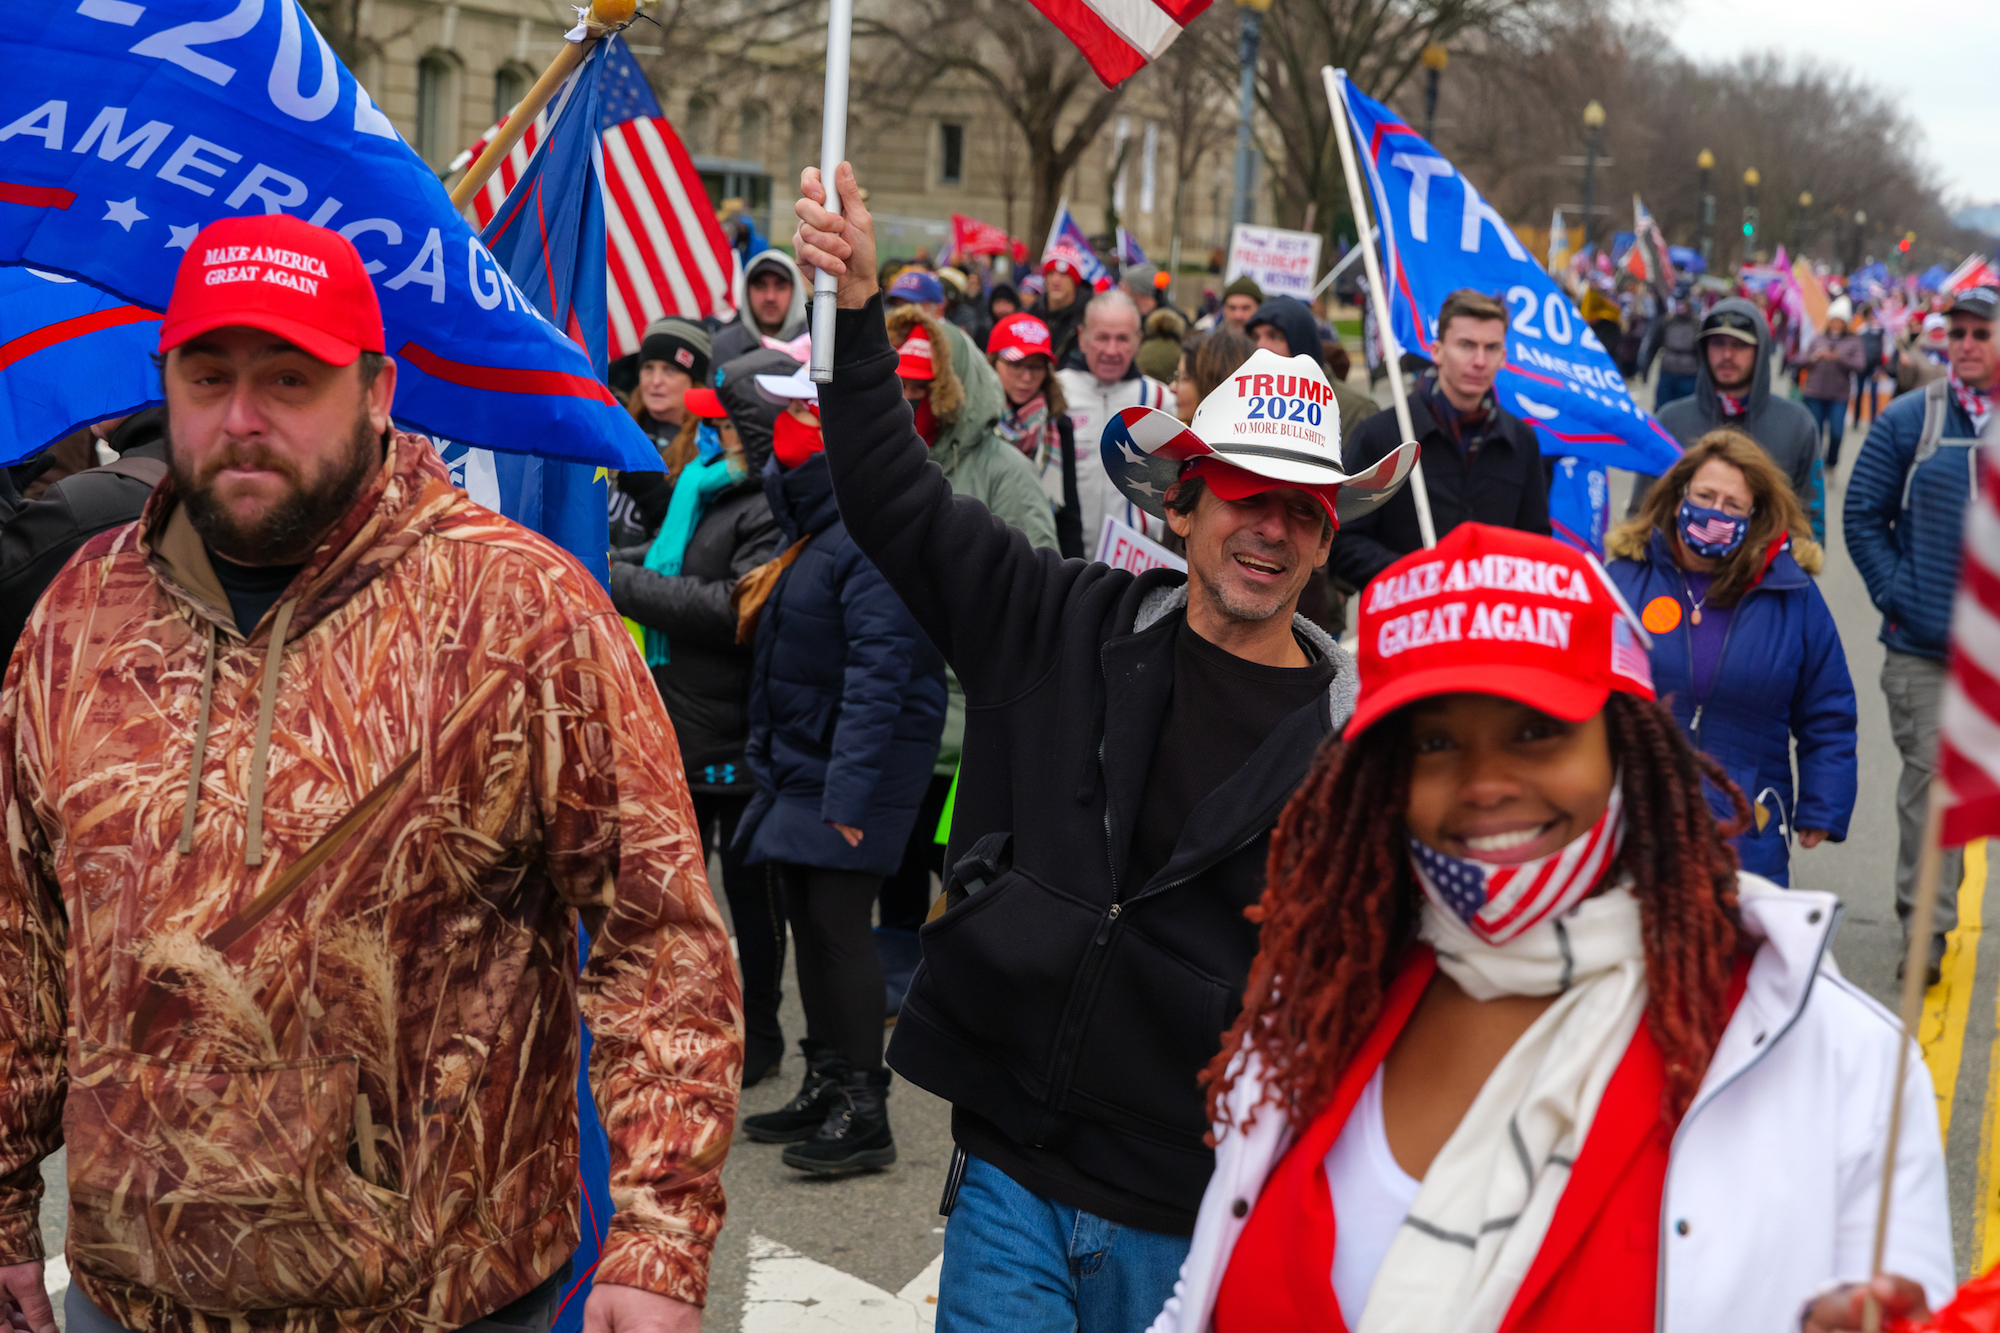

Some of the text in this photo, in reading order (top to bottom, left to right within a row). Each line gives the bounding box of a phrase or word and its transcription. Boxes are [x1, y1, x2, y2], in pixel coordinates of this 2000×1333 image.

[0, 99, 446, 304] AMERICA
[203, 245, 329, 279] MAKE AMERICA
[205, 266, 319, 297] GREAT AGAIN
[1515, 342, 1628, 394] AMERIC
[1234, 374, 1333, 407] TRUMP
[1233, 421, 1247, 435] NO
[1248, 421, 1279, 435] MORE
[1247, 396, 1322, 426] 2020
[1366, 553, 1593, 615] MAKE AMERICA
[1377, 601, 1574, 659] GREAT AGAIN
